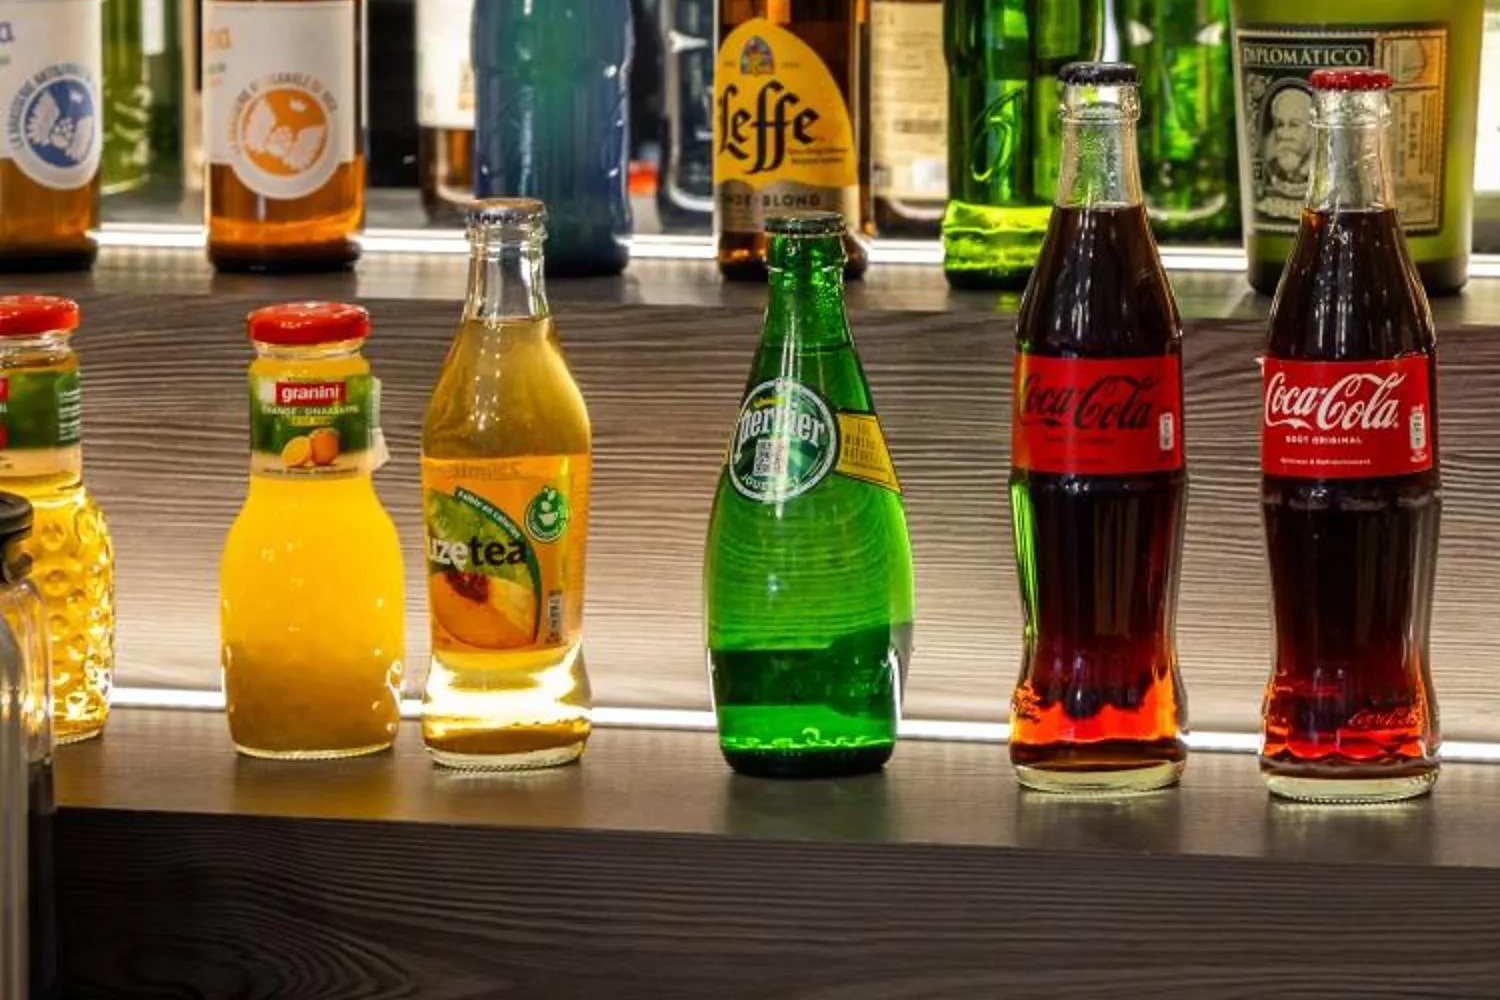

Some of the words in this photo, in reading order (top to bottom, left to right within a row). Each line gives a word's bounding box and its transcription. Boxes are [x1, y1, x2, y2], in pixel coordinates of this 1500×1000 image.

[718, 79, 820, 175] Leffe
[763, 193, 821, 207] BLOND
[281, 385, 340, 404] granini
[1265, 371, 1407, 431] Coca-Cola
